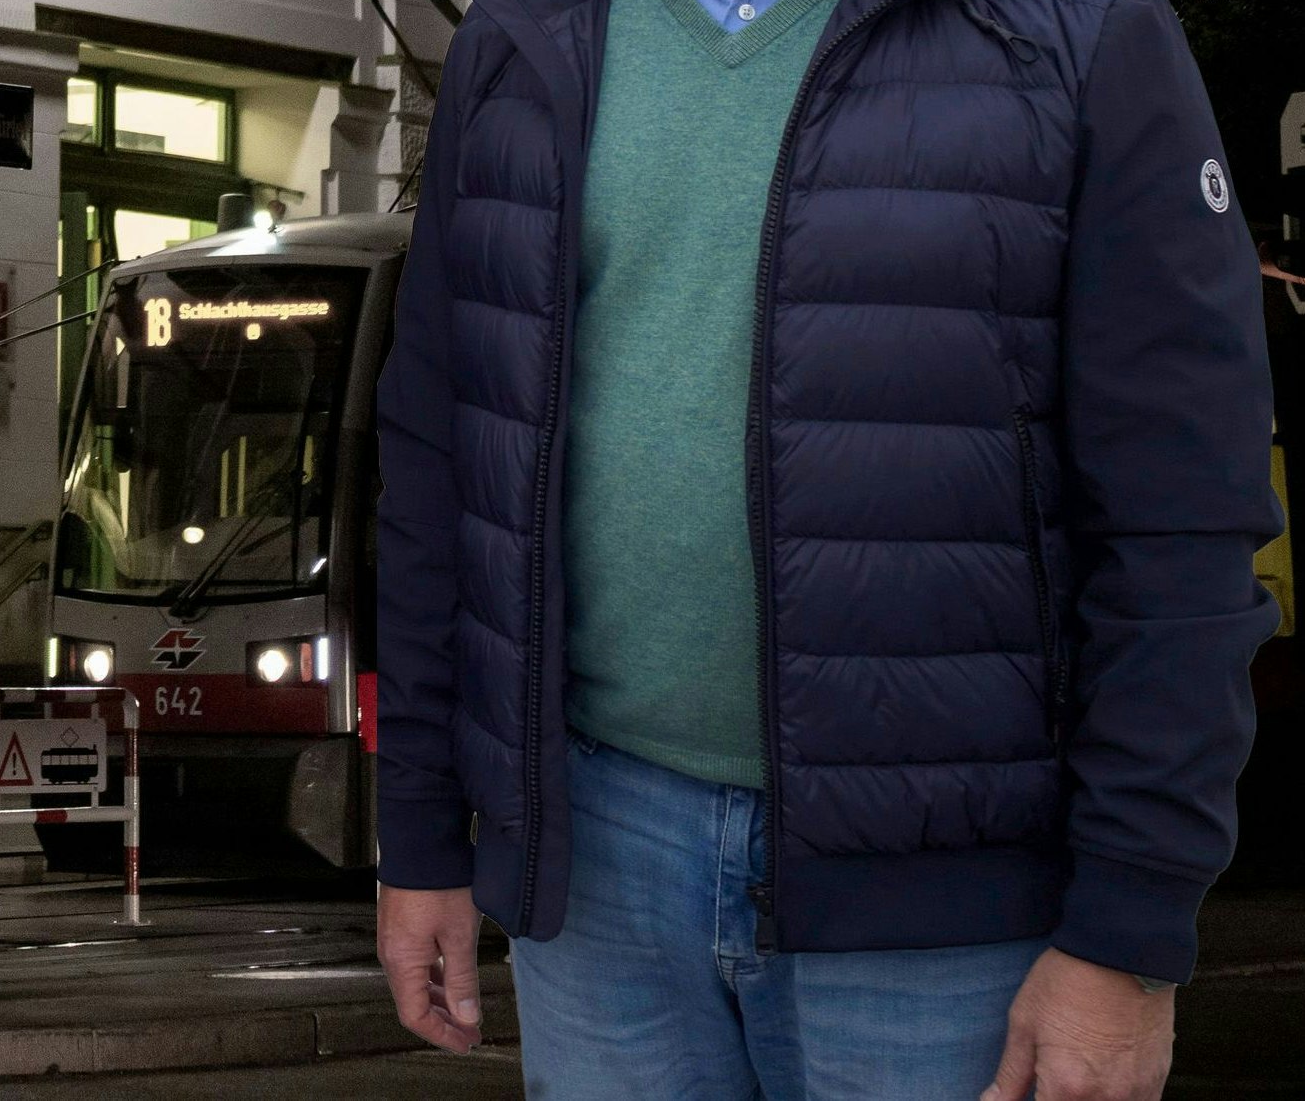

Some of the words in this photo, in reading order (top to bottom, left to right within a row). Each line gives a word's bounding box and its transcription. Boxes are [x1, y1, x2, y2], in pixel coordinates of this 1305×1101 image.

[144, 298, 172, 346] 18
[179, 302, 329, 320] Schlachthausgasse
[155, 686, 203, 716] 642
